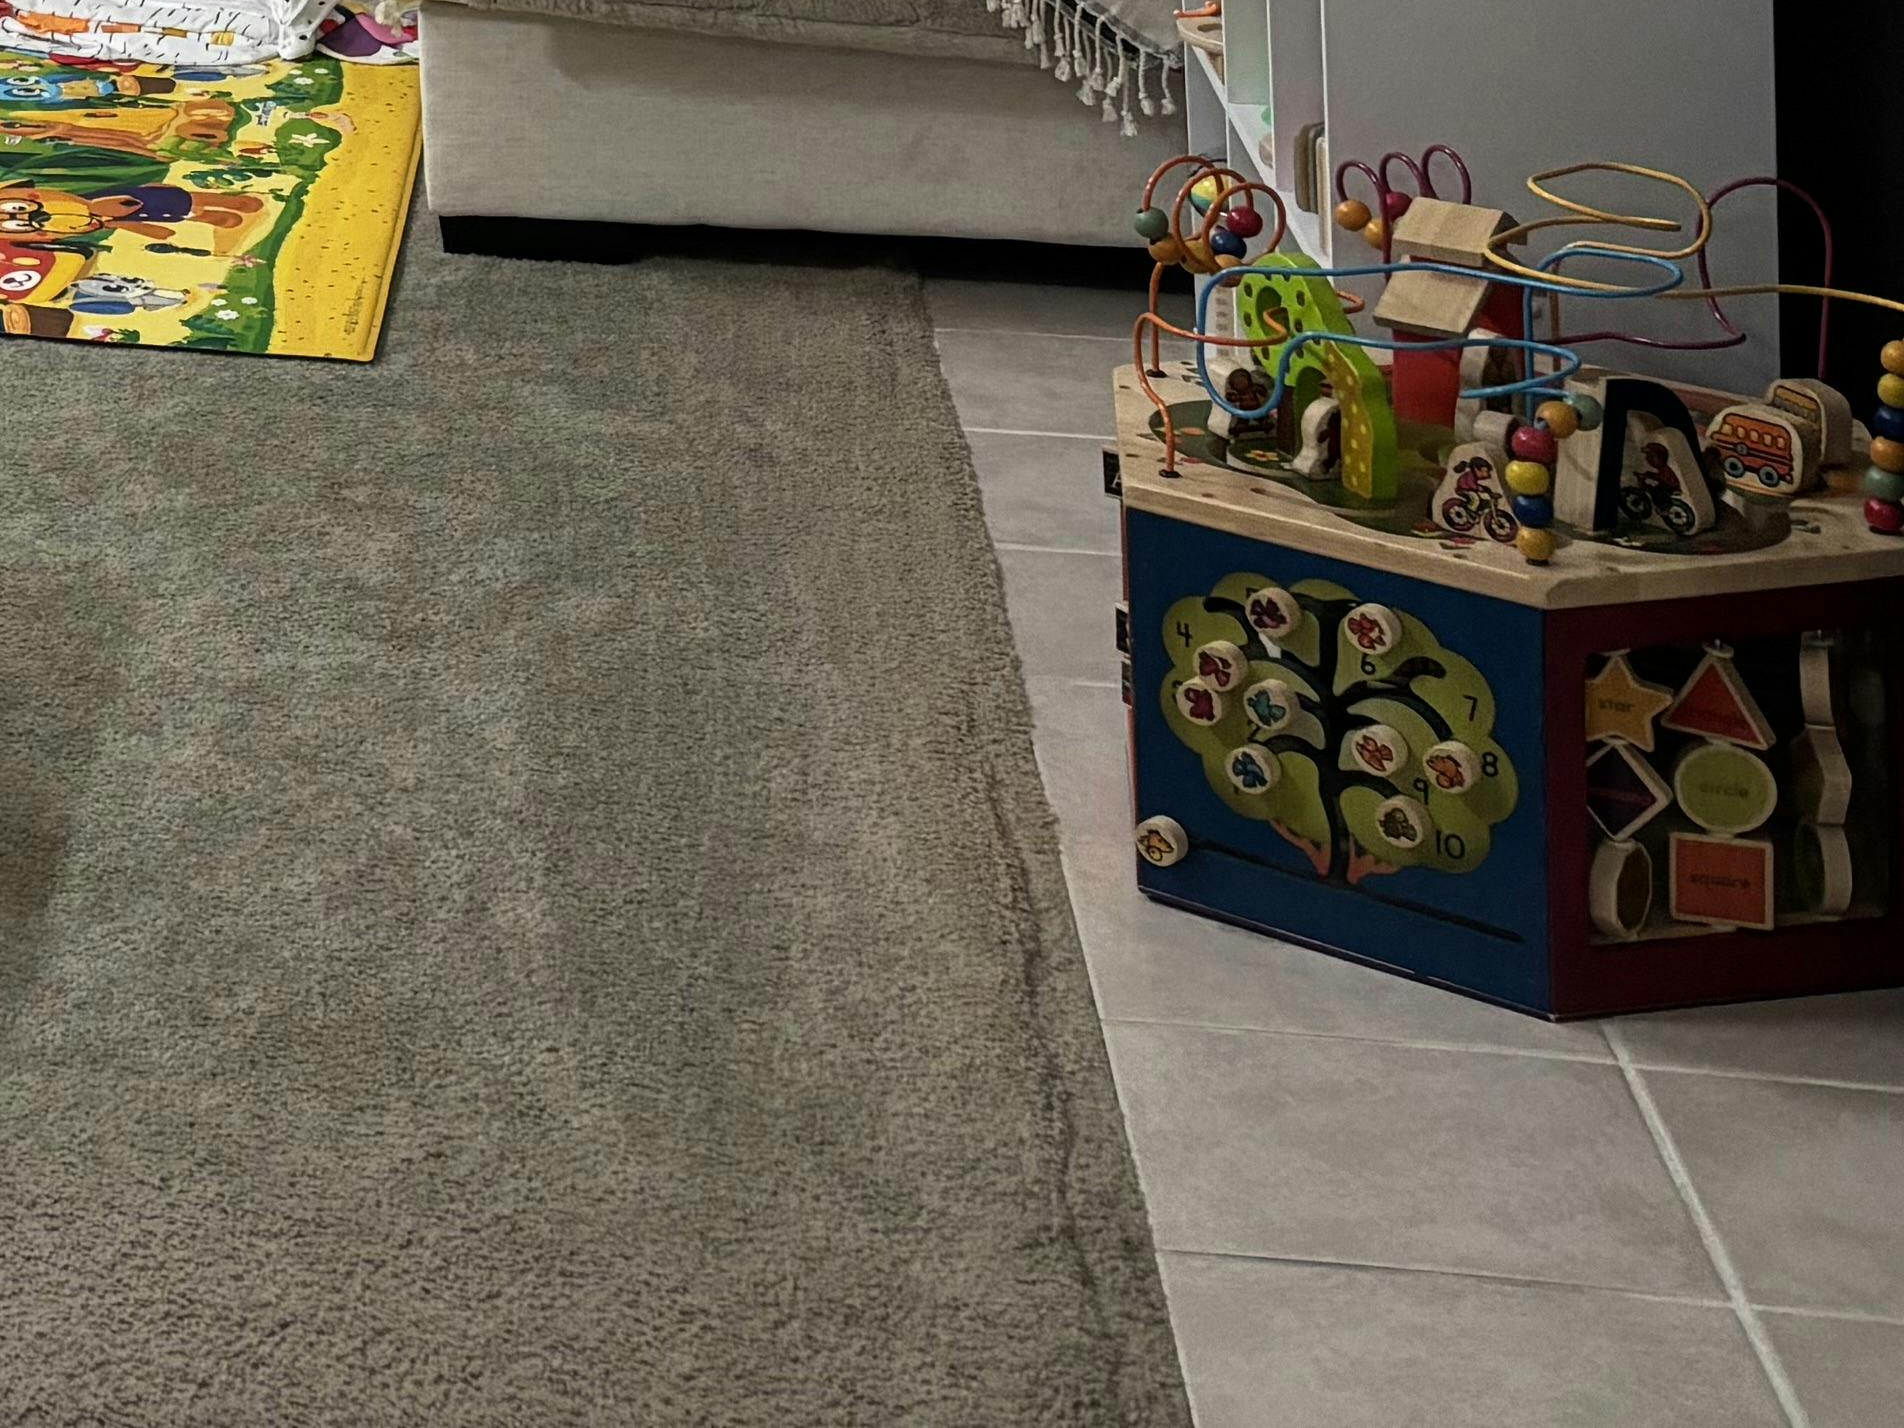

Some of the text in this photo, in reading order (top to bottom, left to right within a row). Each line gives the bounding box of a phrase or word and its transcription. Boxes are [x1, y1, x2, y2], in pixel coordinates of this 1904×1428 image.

[1177, 621, 1191, 647] 4
[1360, 653, 1376, 675] 6
[1463, 695, 1478, 722] 7
[1481, 752, 1498, 778] 8
[1414, 778, 1429, 805] 9
[1436, 832, 1464, 859] 10
